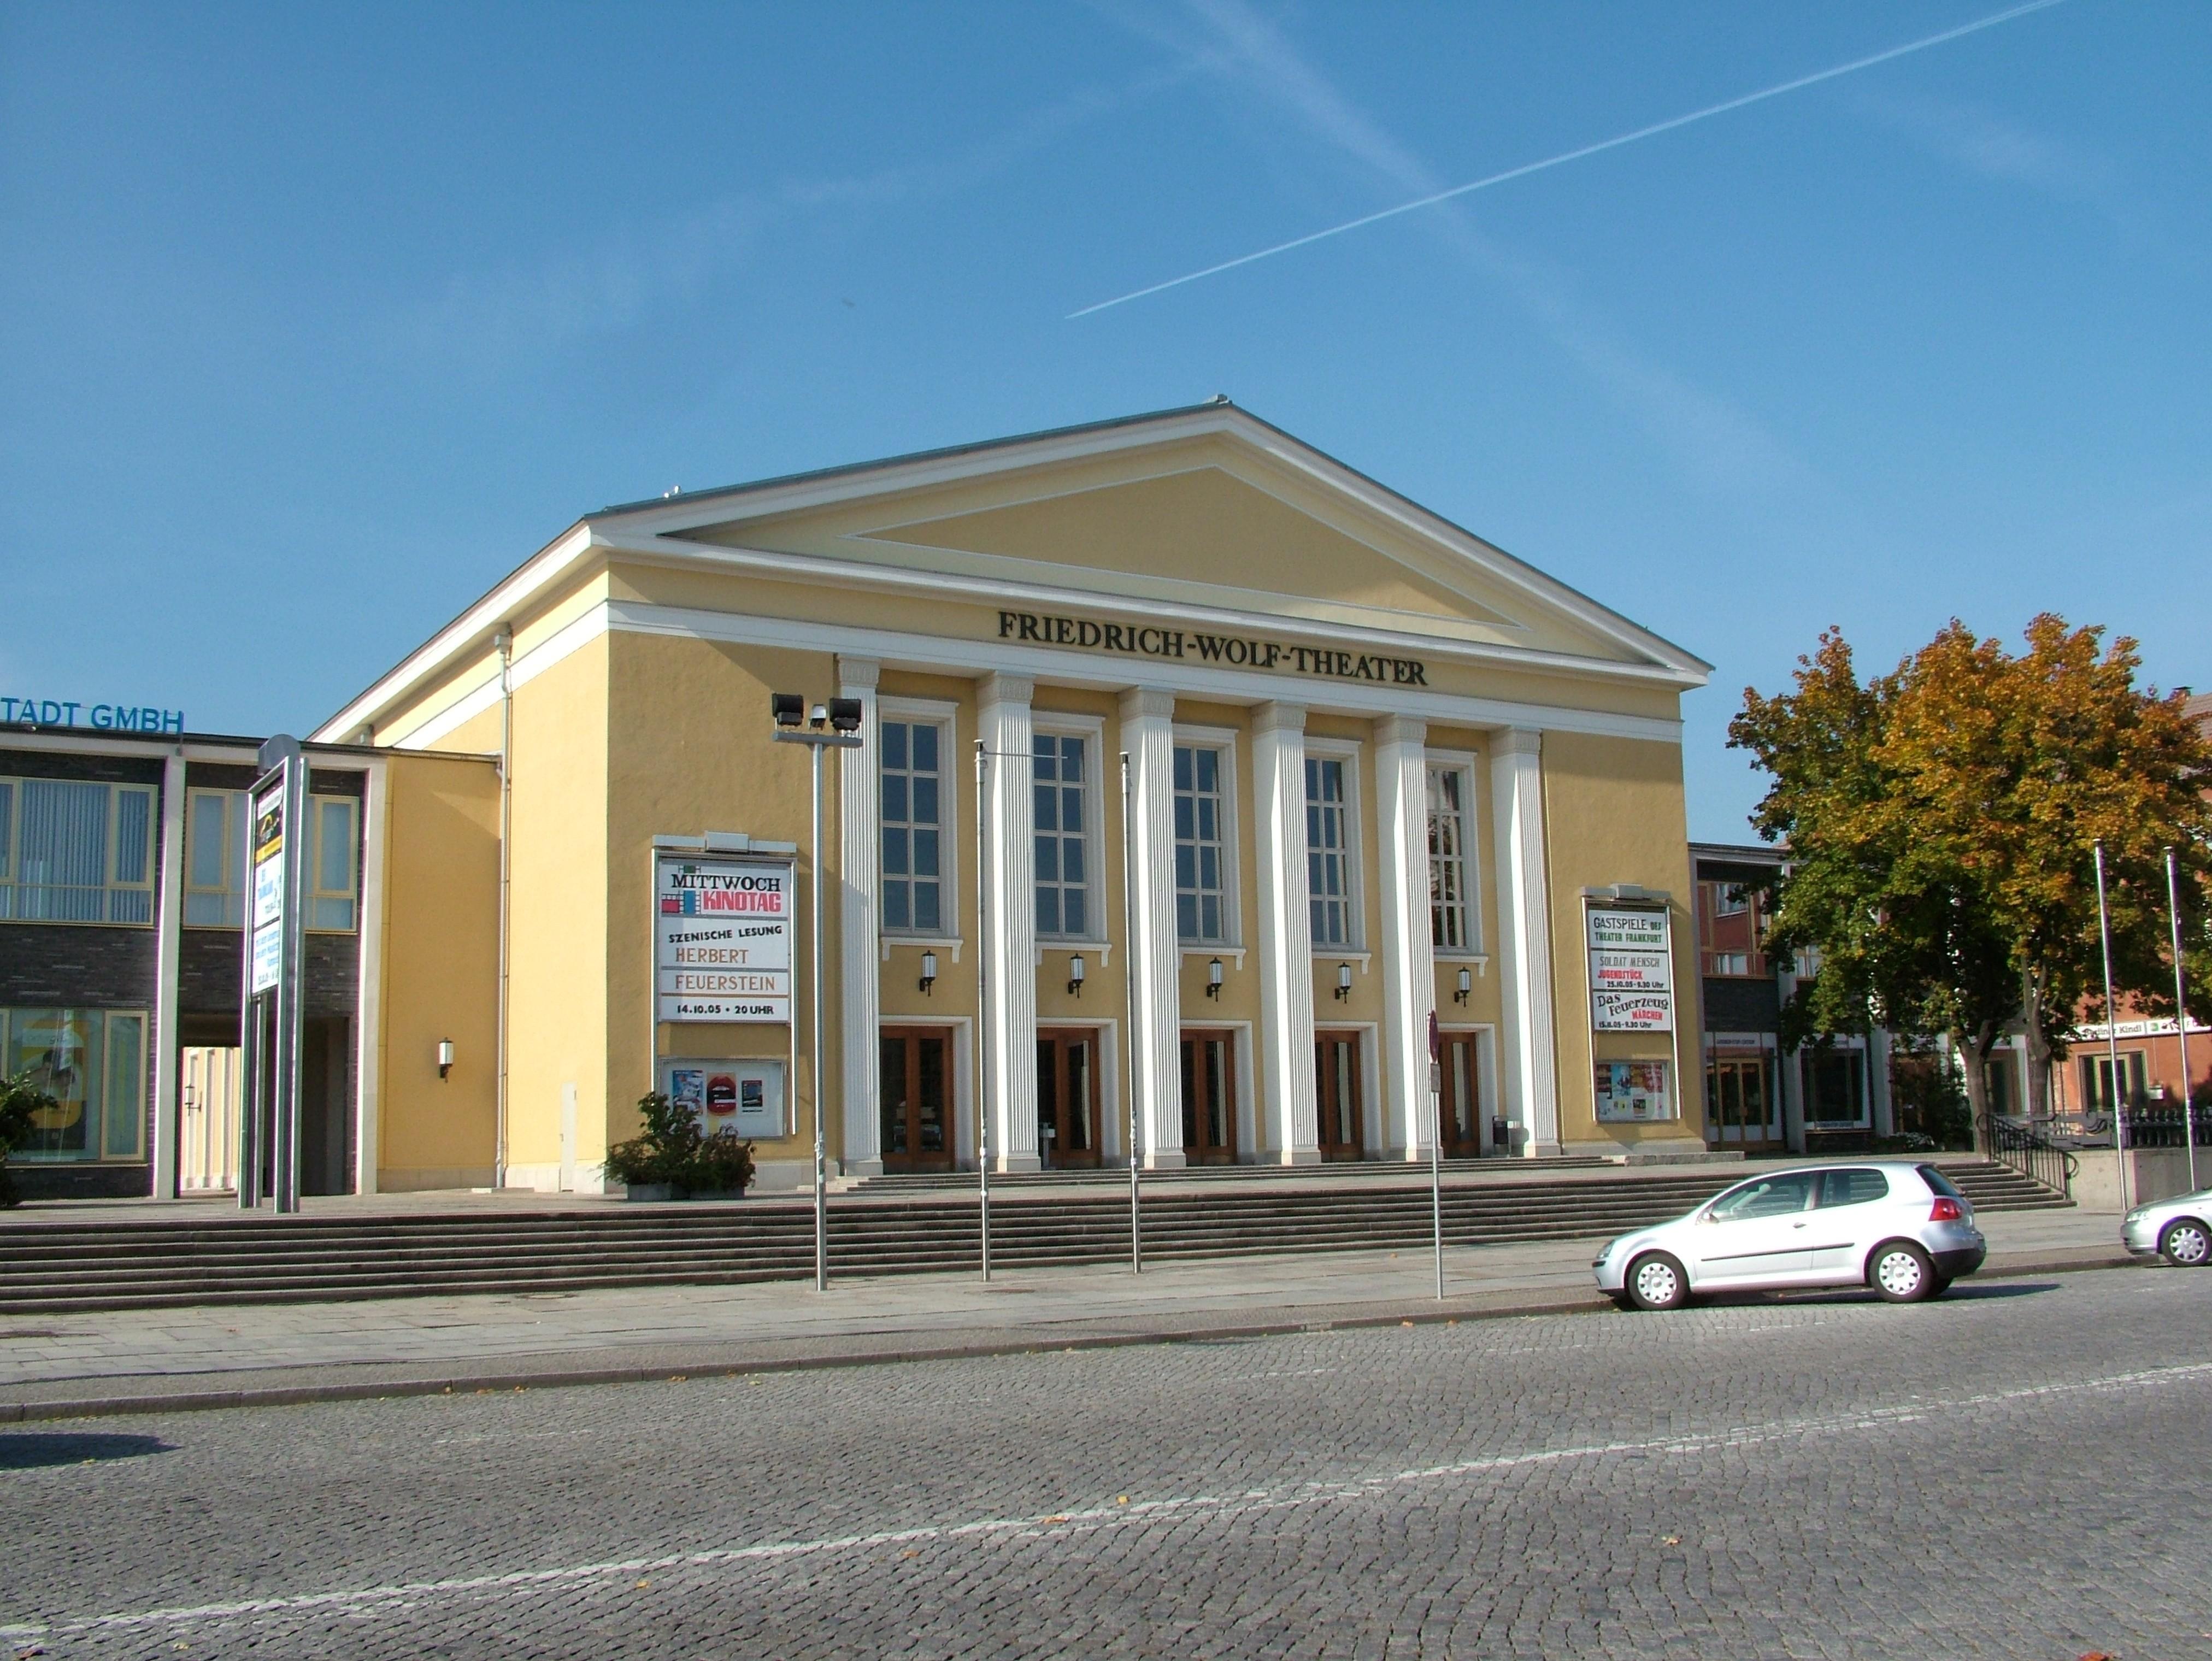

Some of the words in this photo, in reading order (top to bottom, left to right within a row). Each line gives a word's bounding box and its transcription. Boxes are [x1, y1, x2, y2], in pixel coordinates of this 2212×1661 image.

[997, 611, 1428, 686] FRIEDRICH-WOLF-THEATER
[91, 704, 184, 735] GMBH
[671, 874, 781, 892] MITTWOCH
[703, 891, 781, 912] KINOTAG
[1593, 917, 1648, 930] GASTSPIELE
[668, 930, 733, 943] SZENISCHE
[738, 926, 782, 938] LESUNG
[1595, 932, 1623, 941] THEATER
[1626, 933, 1662, 943] FRANKFURT
[675, 947, 749, 963] HERBERT
[1599, 956, 1627, 967] SOLDAT
[1630, 957, 1660, 967] MENSCH
[1598, 969, 1643, 979] JUGENDSTÜCK
[675, 975, 775, 991] FEUERSTEIN
[1597, 993, 1621, 1007] Das
[1609, 998, 1669, 1016] Feuerzeug
[677, 1004, 721, 1014] 14.10.05
[734, 1005, 748, 1014] 20
[750, 1005, 774, 1015] UHR
[1632, 1009, 1663, 1021] MÄRCHEN
